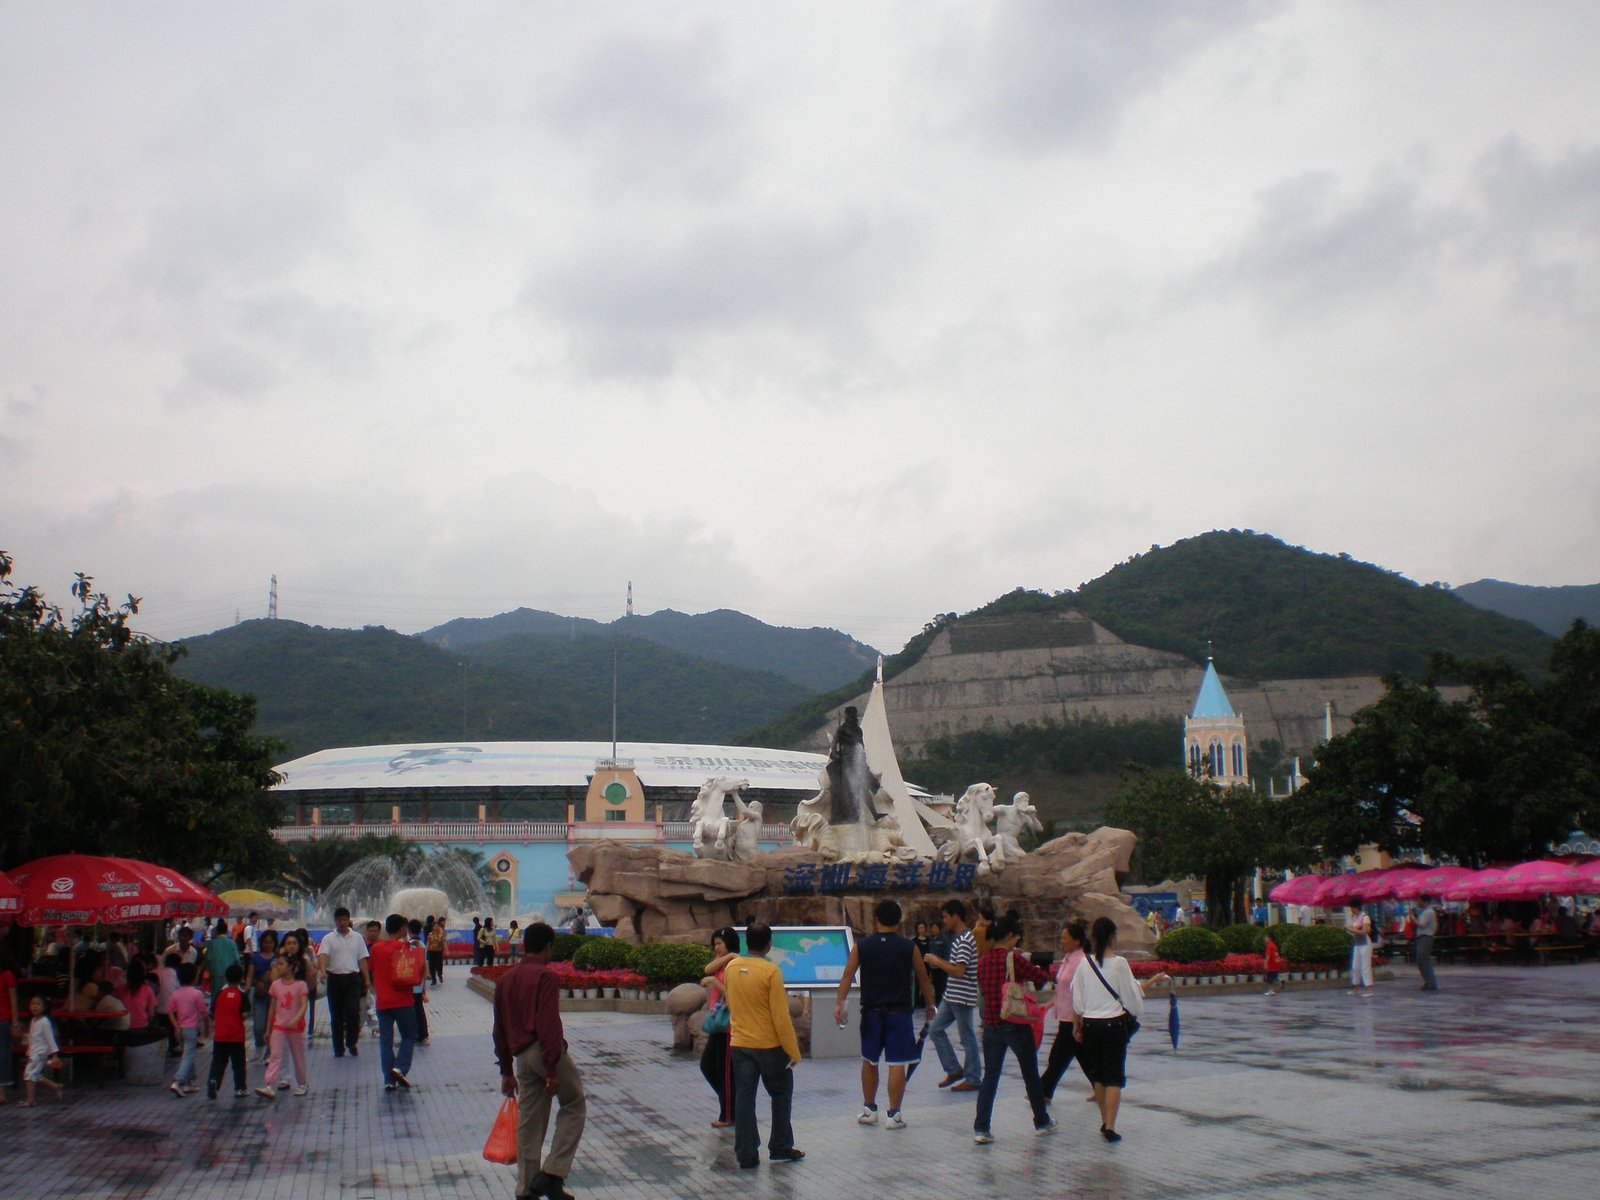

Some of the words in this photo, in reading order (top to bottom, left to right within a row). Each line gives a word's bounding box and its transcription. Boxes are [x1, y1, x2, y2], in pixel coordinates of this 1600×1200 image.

[783, 862, 977, 892] 深圳海洋世界
